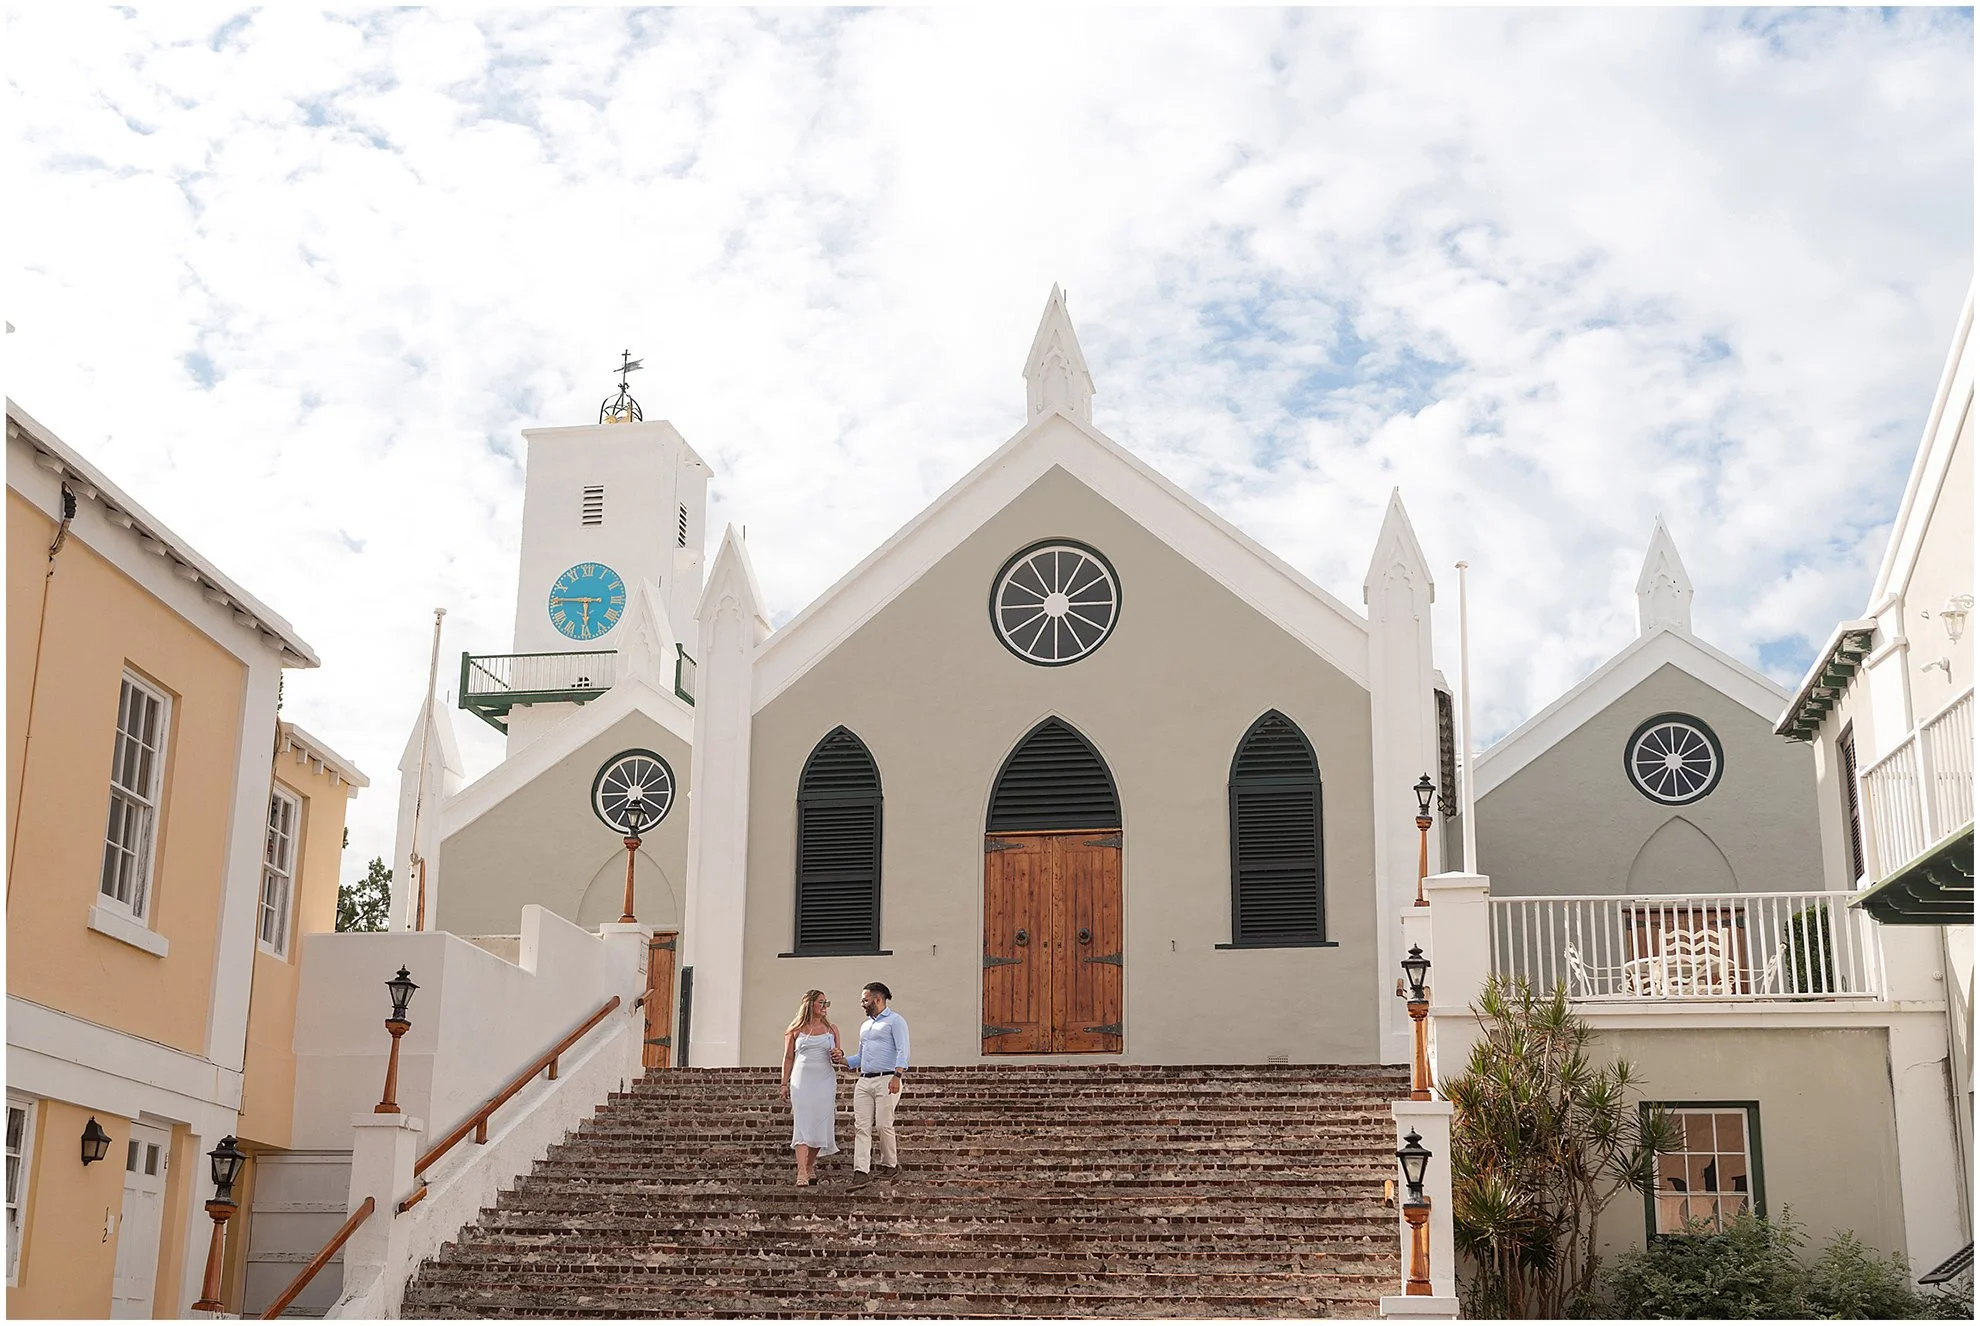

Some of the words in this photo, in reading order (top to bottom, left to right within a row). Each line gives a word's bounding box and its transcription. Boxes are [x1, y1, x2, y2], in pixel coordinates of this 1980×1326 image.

[582, 566, 594, 577] XII
[600, 568, 608, 579] I
[608, 582, 620, 590] II
[610, 595, 622, 605] III
